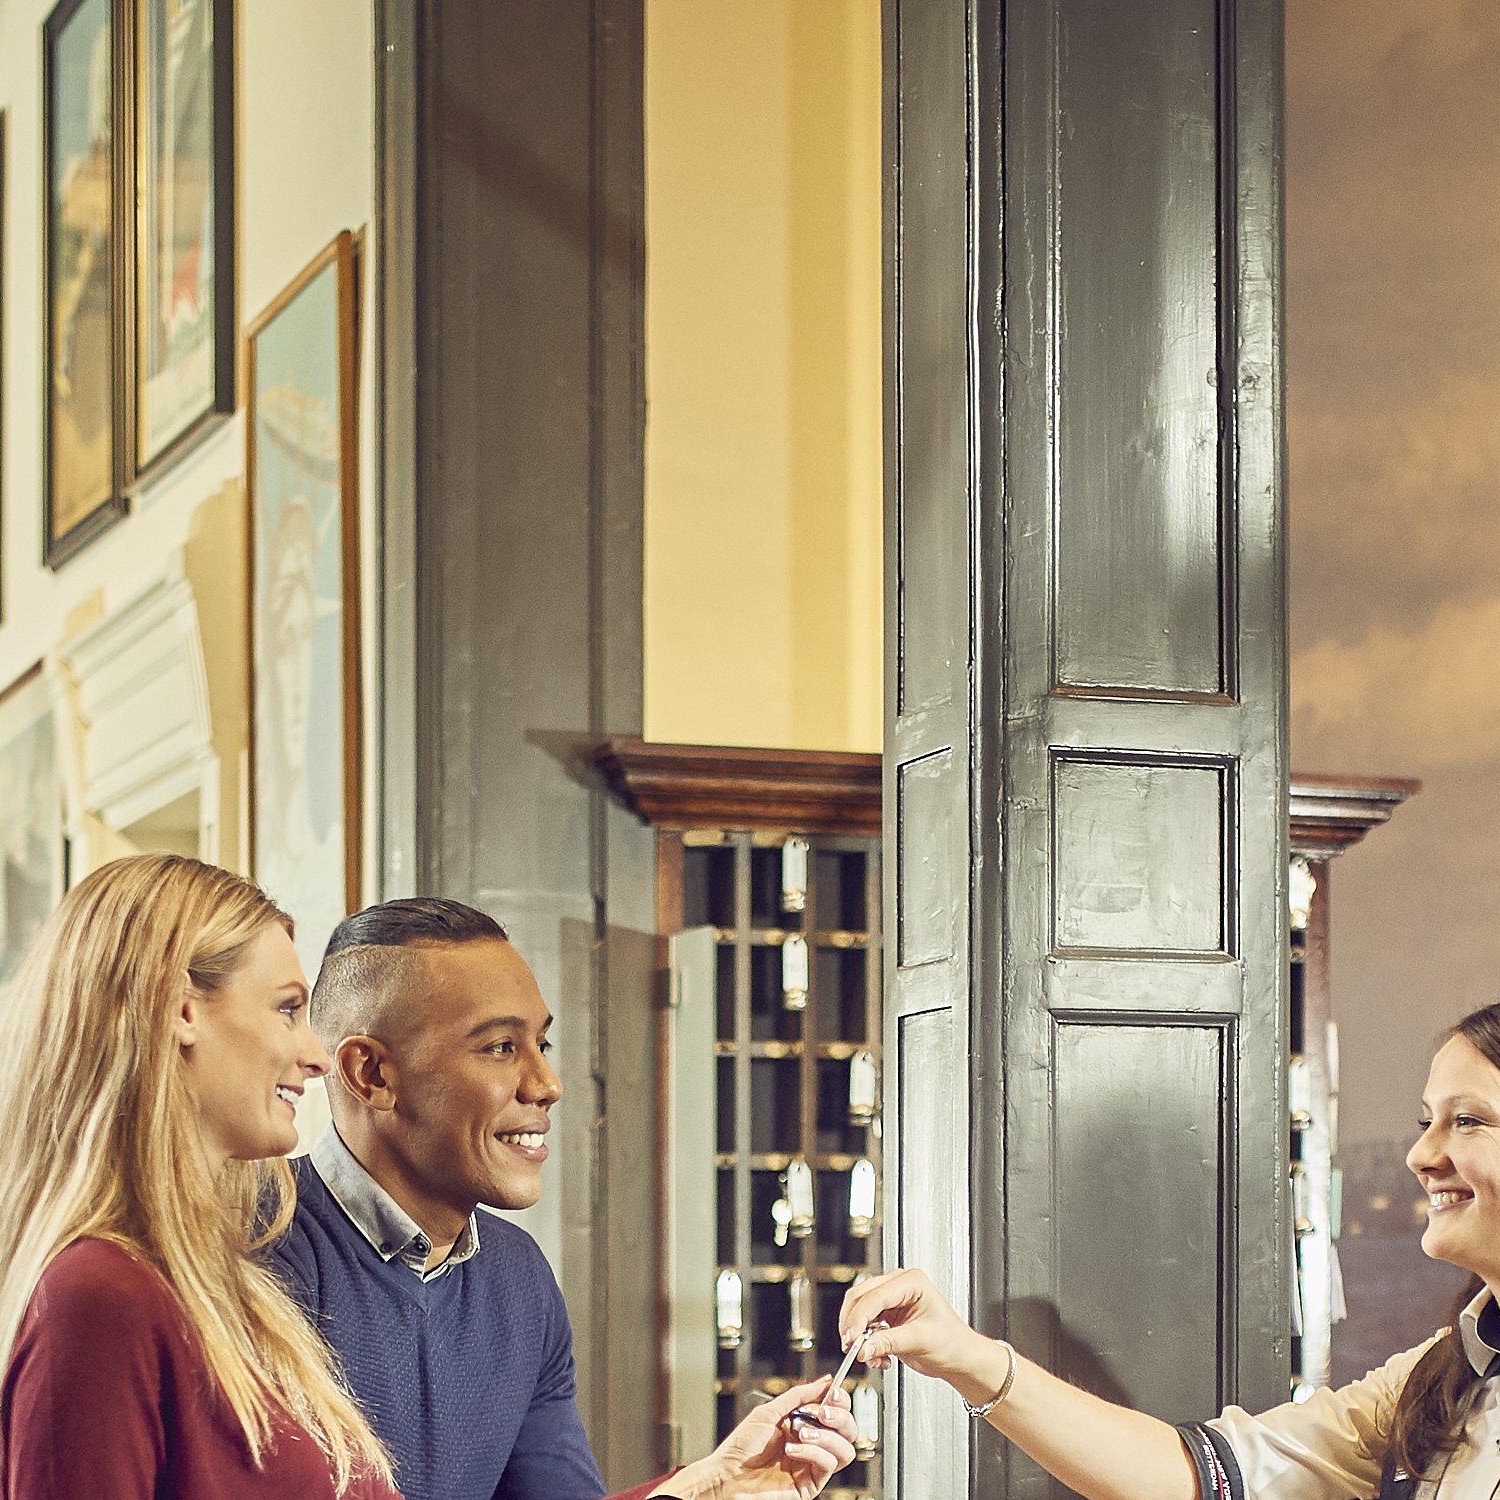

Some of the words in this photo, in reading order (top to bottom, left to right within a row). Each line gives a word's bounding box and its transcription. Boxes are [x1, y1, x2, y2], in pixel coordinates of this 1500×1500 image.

[1202, 1432, 1218, 1460] HOTEL
[1216, 1460, 1229, 1481] NEW
[1202, 1444, 1219, 1491] ROTTERDAM
